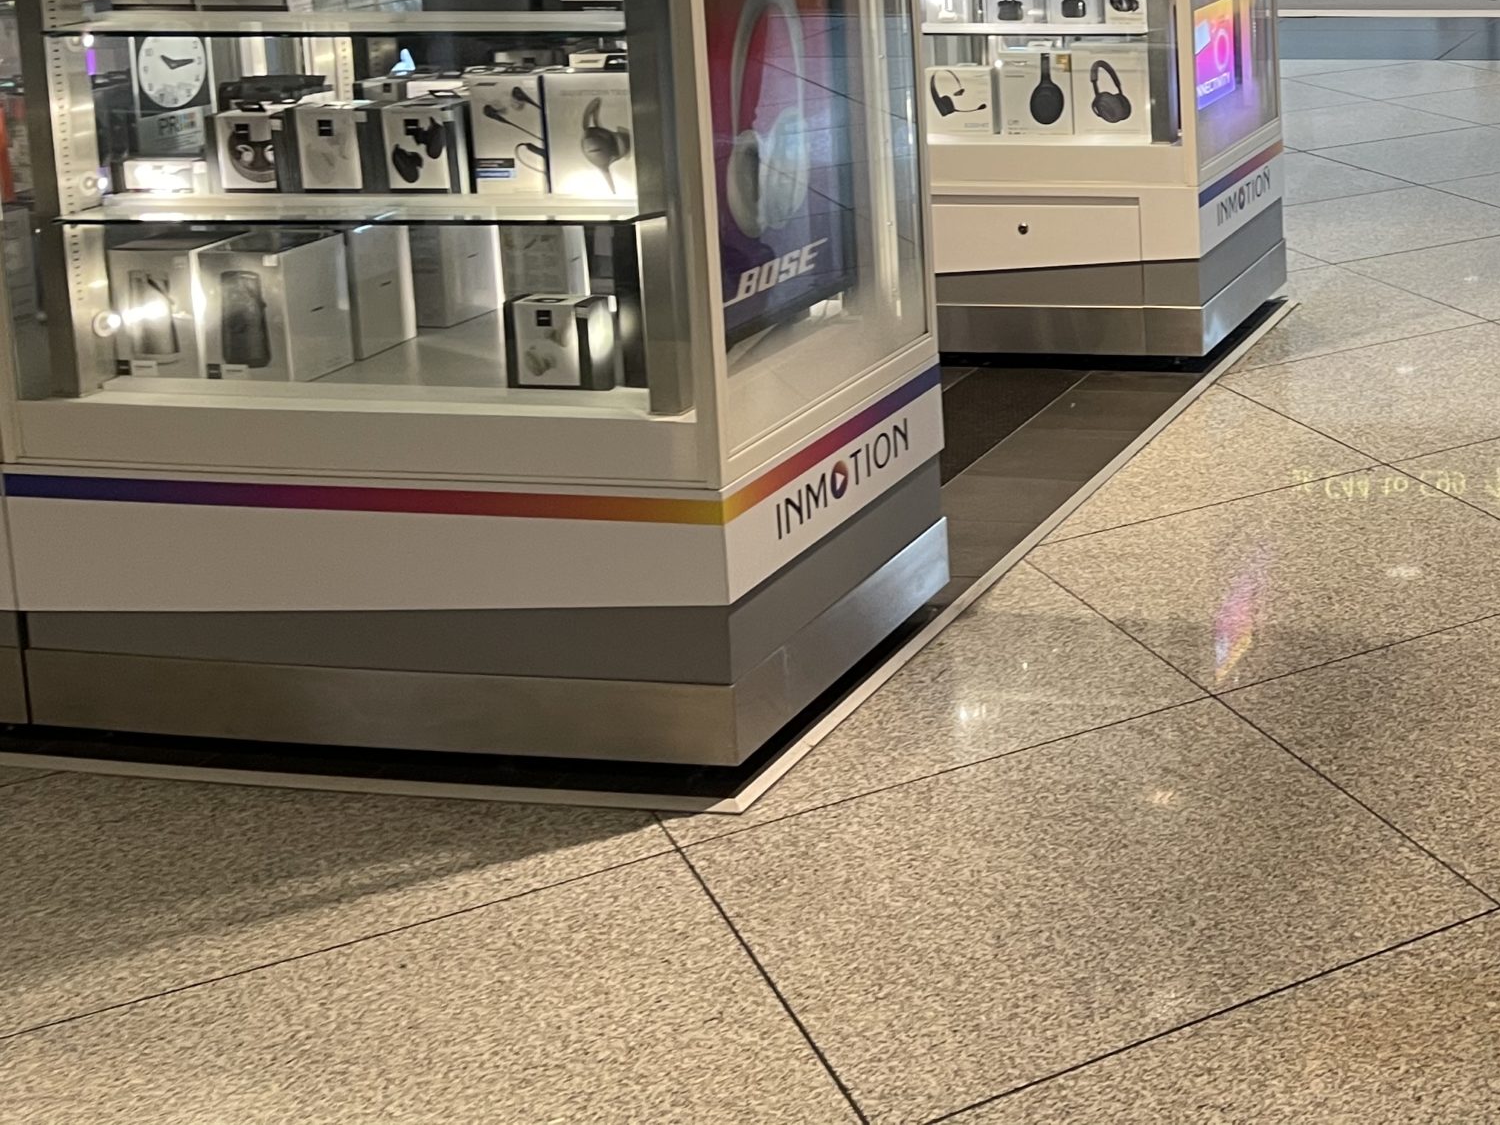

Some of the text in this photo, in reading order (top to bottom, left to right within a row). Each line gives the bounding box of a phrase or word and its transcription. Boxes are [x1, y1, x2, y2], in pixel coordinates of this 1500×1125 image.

[1217, 165, 1271, 227] INMOTION
[723, 237, 829, 308] BOSE
[776, 417, 910, 540] INMOTION
